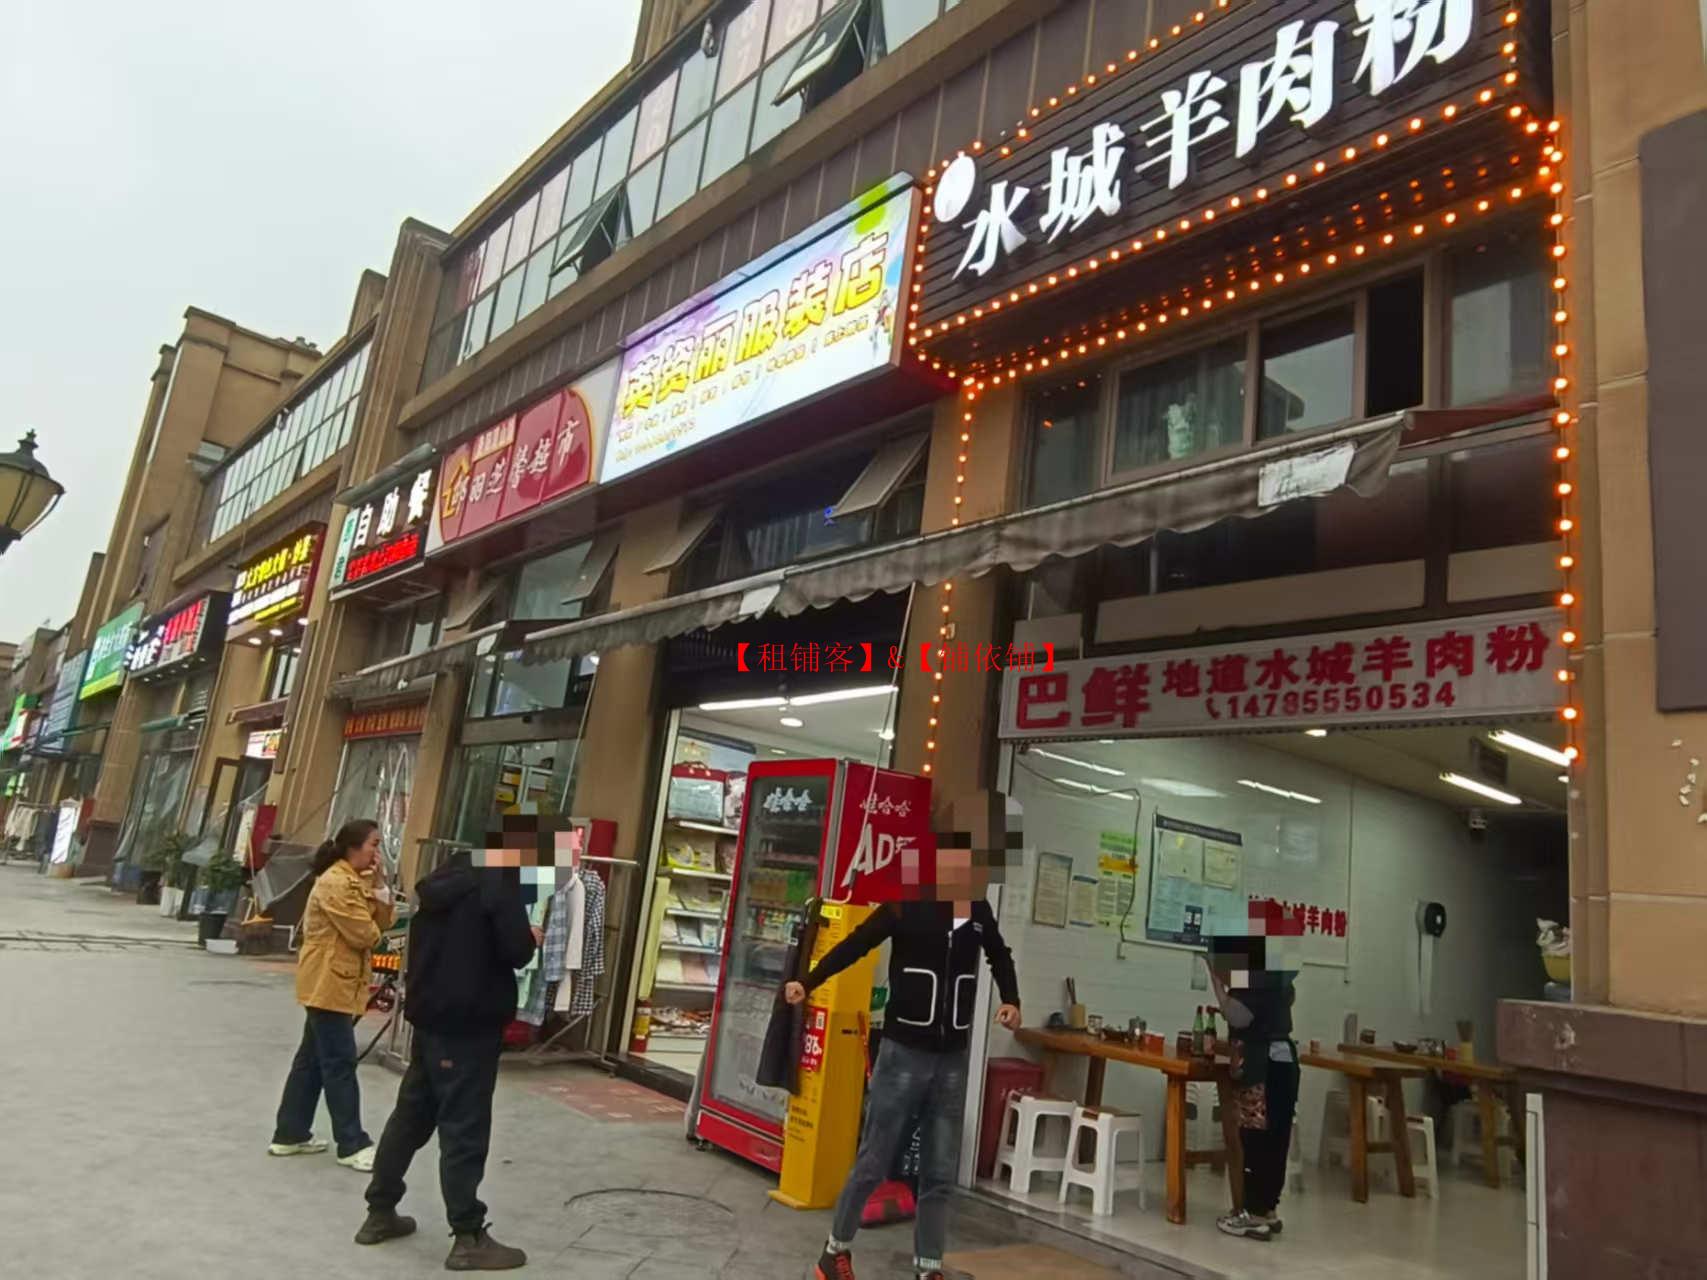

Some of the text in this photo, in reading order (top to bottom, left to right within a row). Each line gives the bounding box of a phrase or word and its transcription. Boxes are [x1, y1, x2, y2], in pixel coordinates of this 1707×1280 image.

[952, 0, 1474, 281] 水城羊肉粉
[1016, 622, 1549, 730] 巴鲜 地道水城羊肉粉
[1226, 680, 1457, 720] 14785550534
